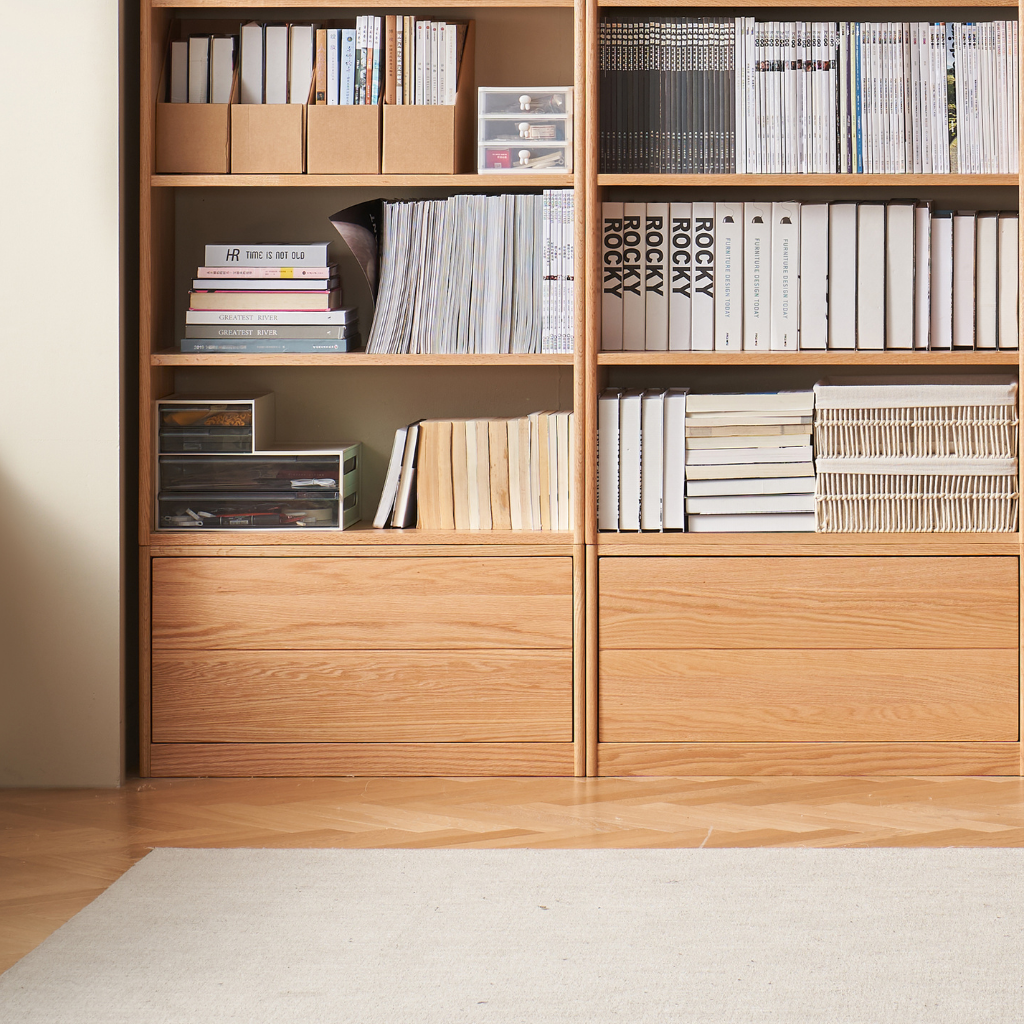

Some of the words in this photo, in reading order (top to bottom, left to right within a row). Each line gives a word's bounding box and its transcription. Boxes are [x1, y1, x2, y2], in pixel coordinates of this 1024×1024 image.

[226, 248, 240, 262] HR
[246, 250, 263, 260] TIME
[276, 251, 288, 260] NOT
[292, 251, 305, 260] OLD
[604, 218, 622, 298] ROCKY
[623, 216, 641, 296] ROCKY
[646, 216, 664, 296] ROCKY
[672, 218, 690, 298] ROCKY
[695, 218, 714, 298] ROCKY
